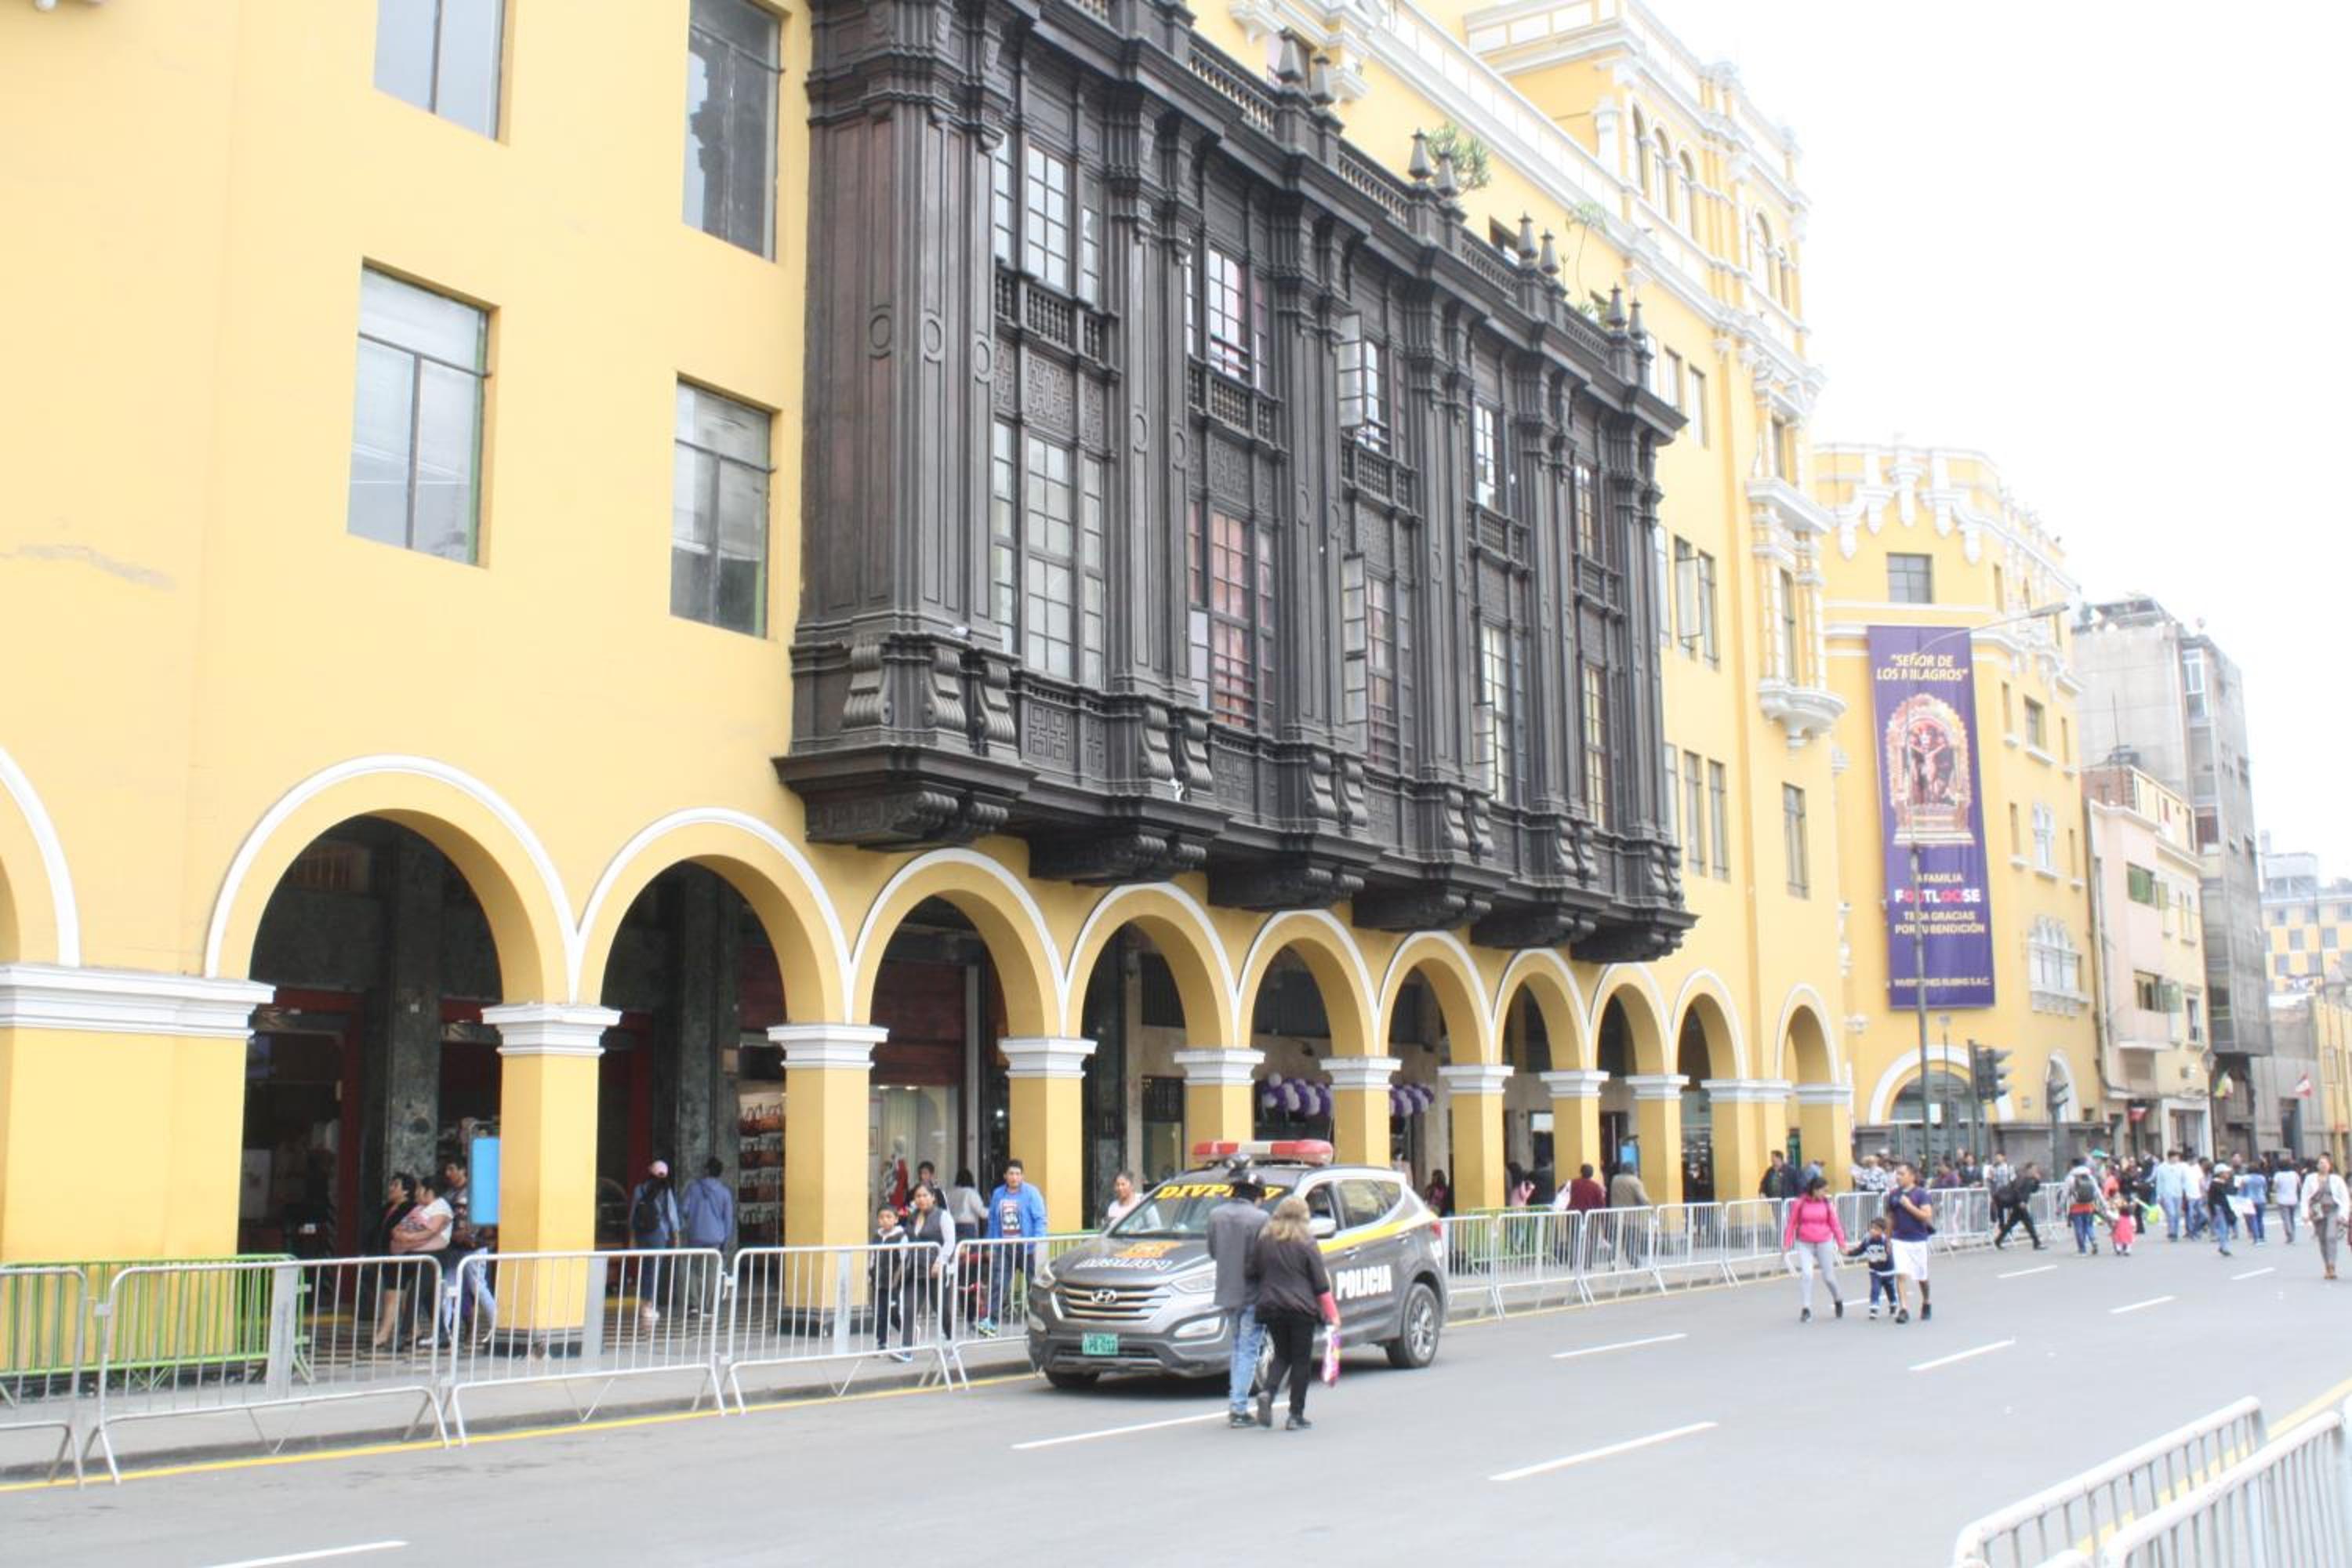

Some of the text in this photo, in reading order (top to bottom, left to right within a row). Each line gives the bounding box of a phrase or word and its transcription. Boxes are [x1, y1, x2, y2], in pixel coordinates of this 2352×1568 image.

[1937, 654, 1954, 666] DE
[1876, 666, 1899, 680] LOS
[1923, 873, 1963, 883] FAMILIA
[1931, 910, 1975, 921] GRACIAS
[1895, 924, 1915, 935] POR
[1929, 922, 1985, 935] BENDICIÓN
[1335, 1264, 1393, 1301] POLICIA
